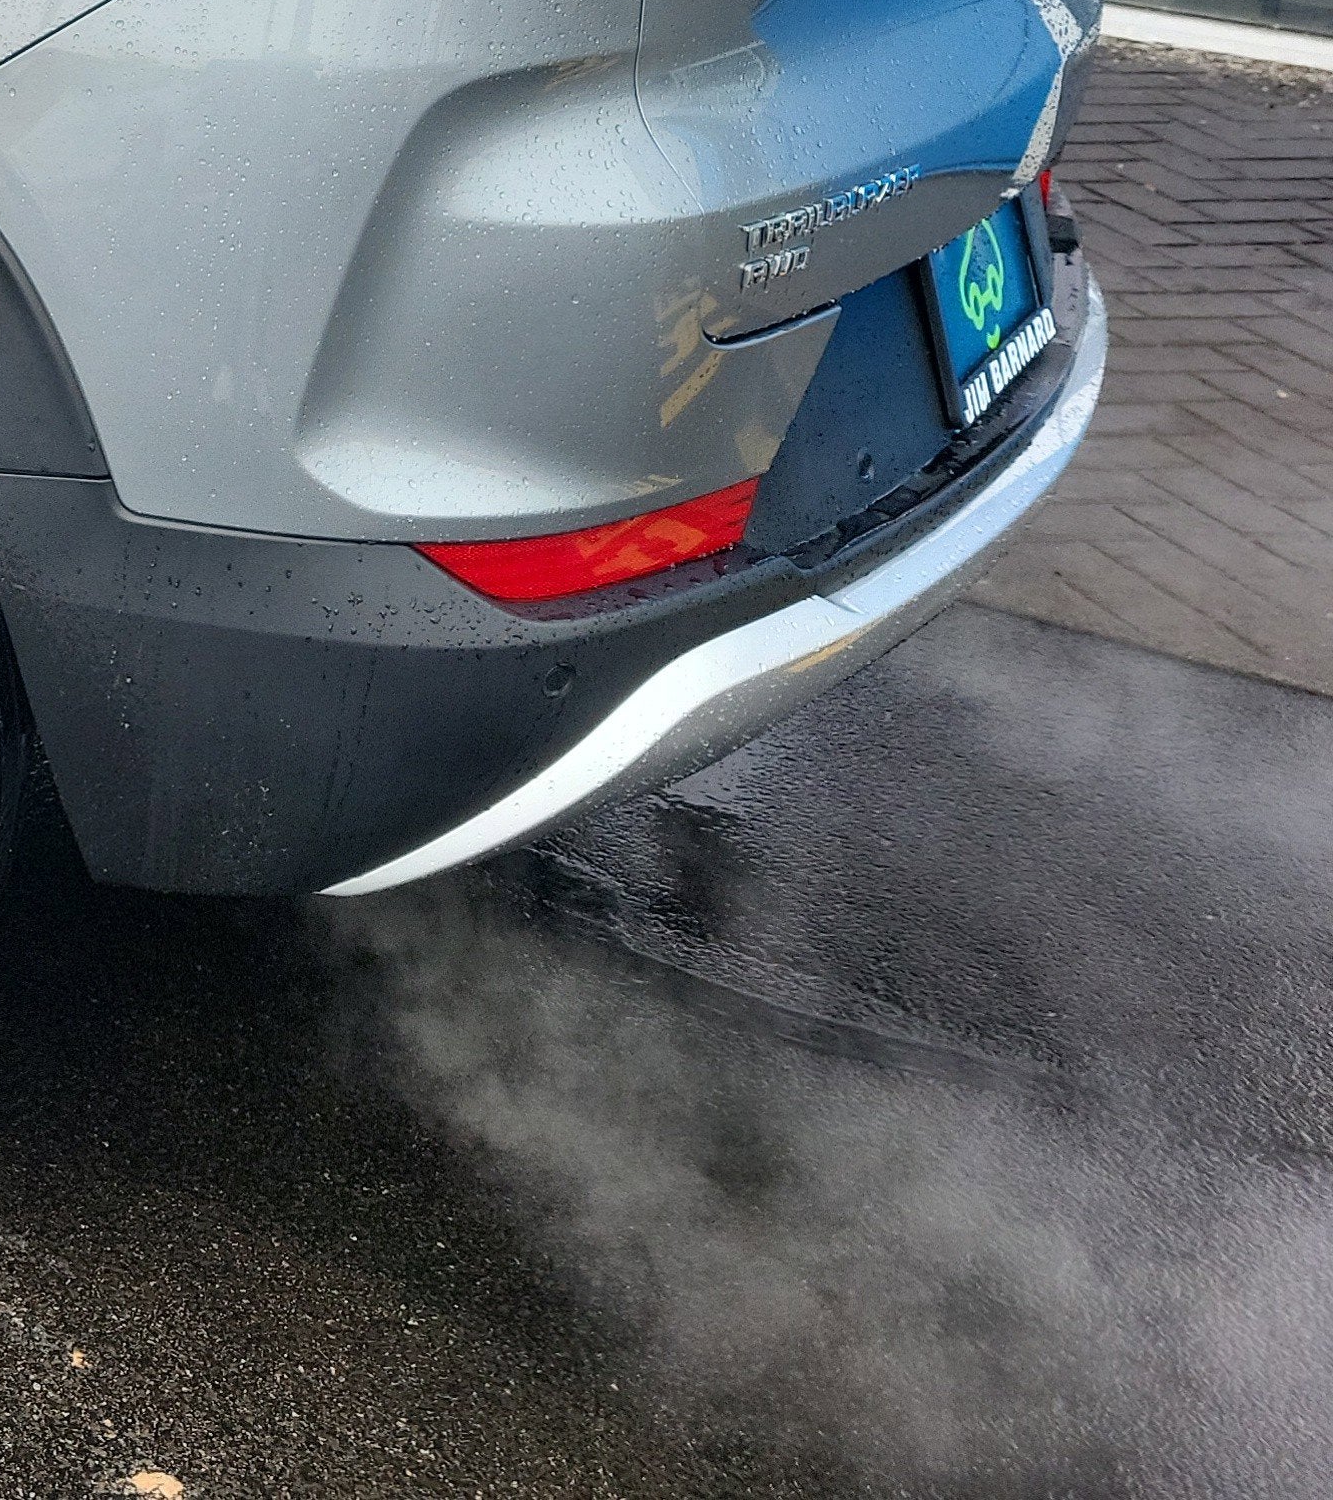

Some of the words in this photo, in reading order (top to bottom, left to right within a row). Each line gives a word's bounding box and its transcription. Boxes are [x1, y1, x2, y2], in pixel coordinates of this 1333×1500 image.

[739, 245, 810, 290] AWD
[963, 371, 992, 425] JIM
[988, 307, 1057, 395] BARNARD
